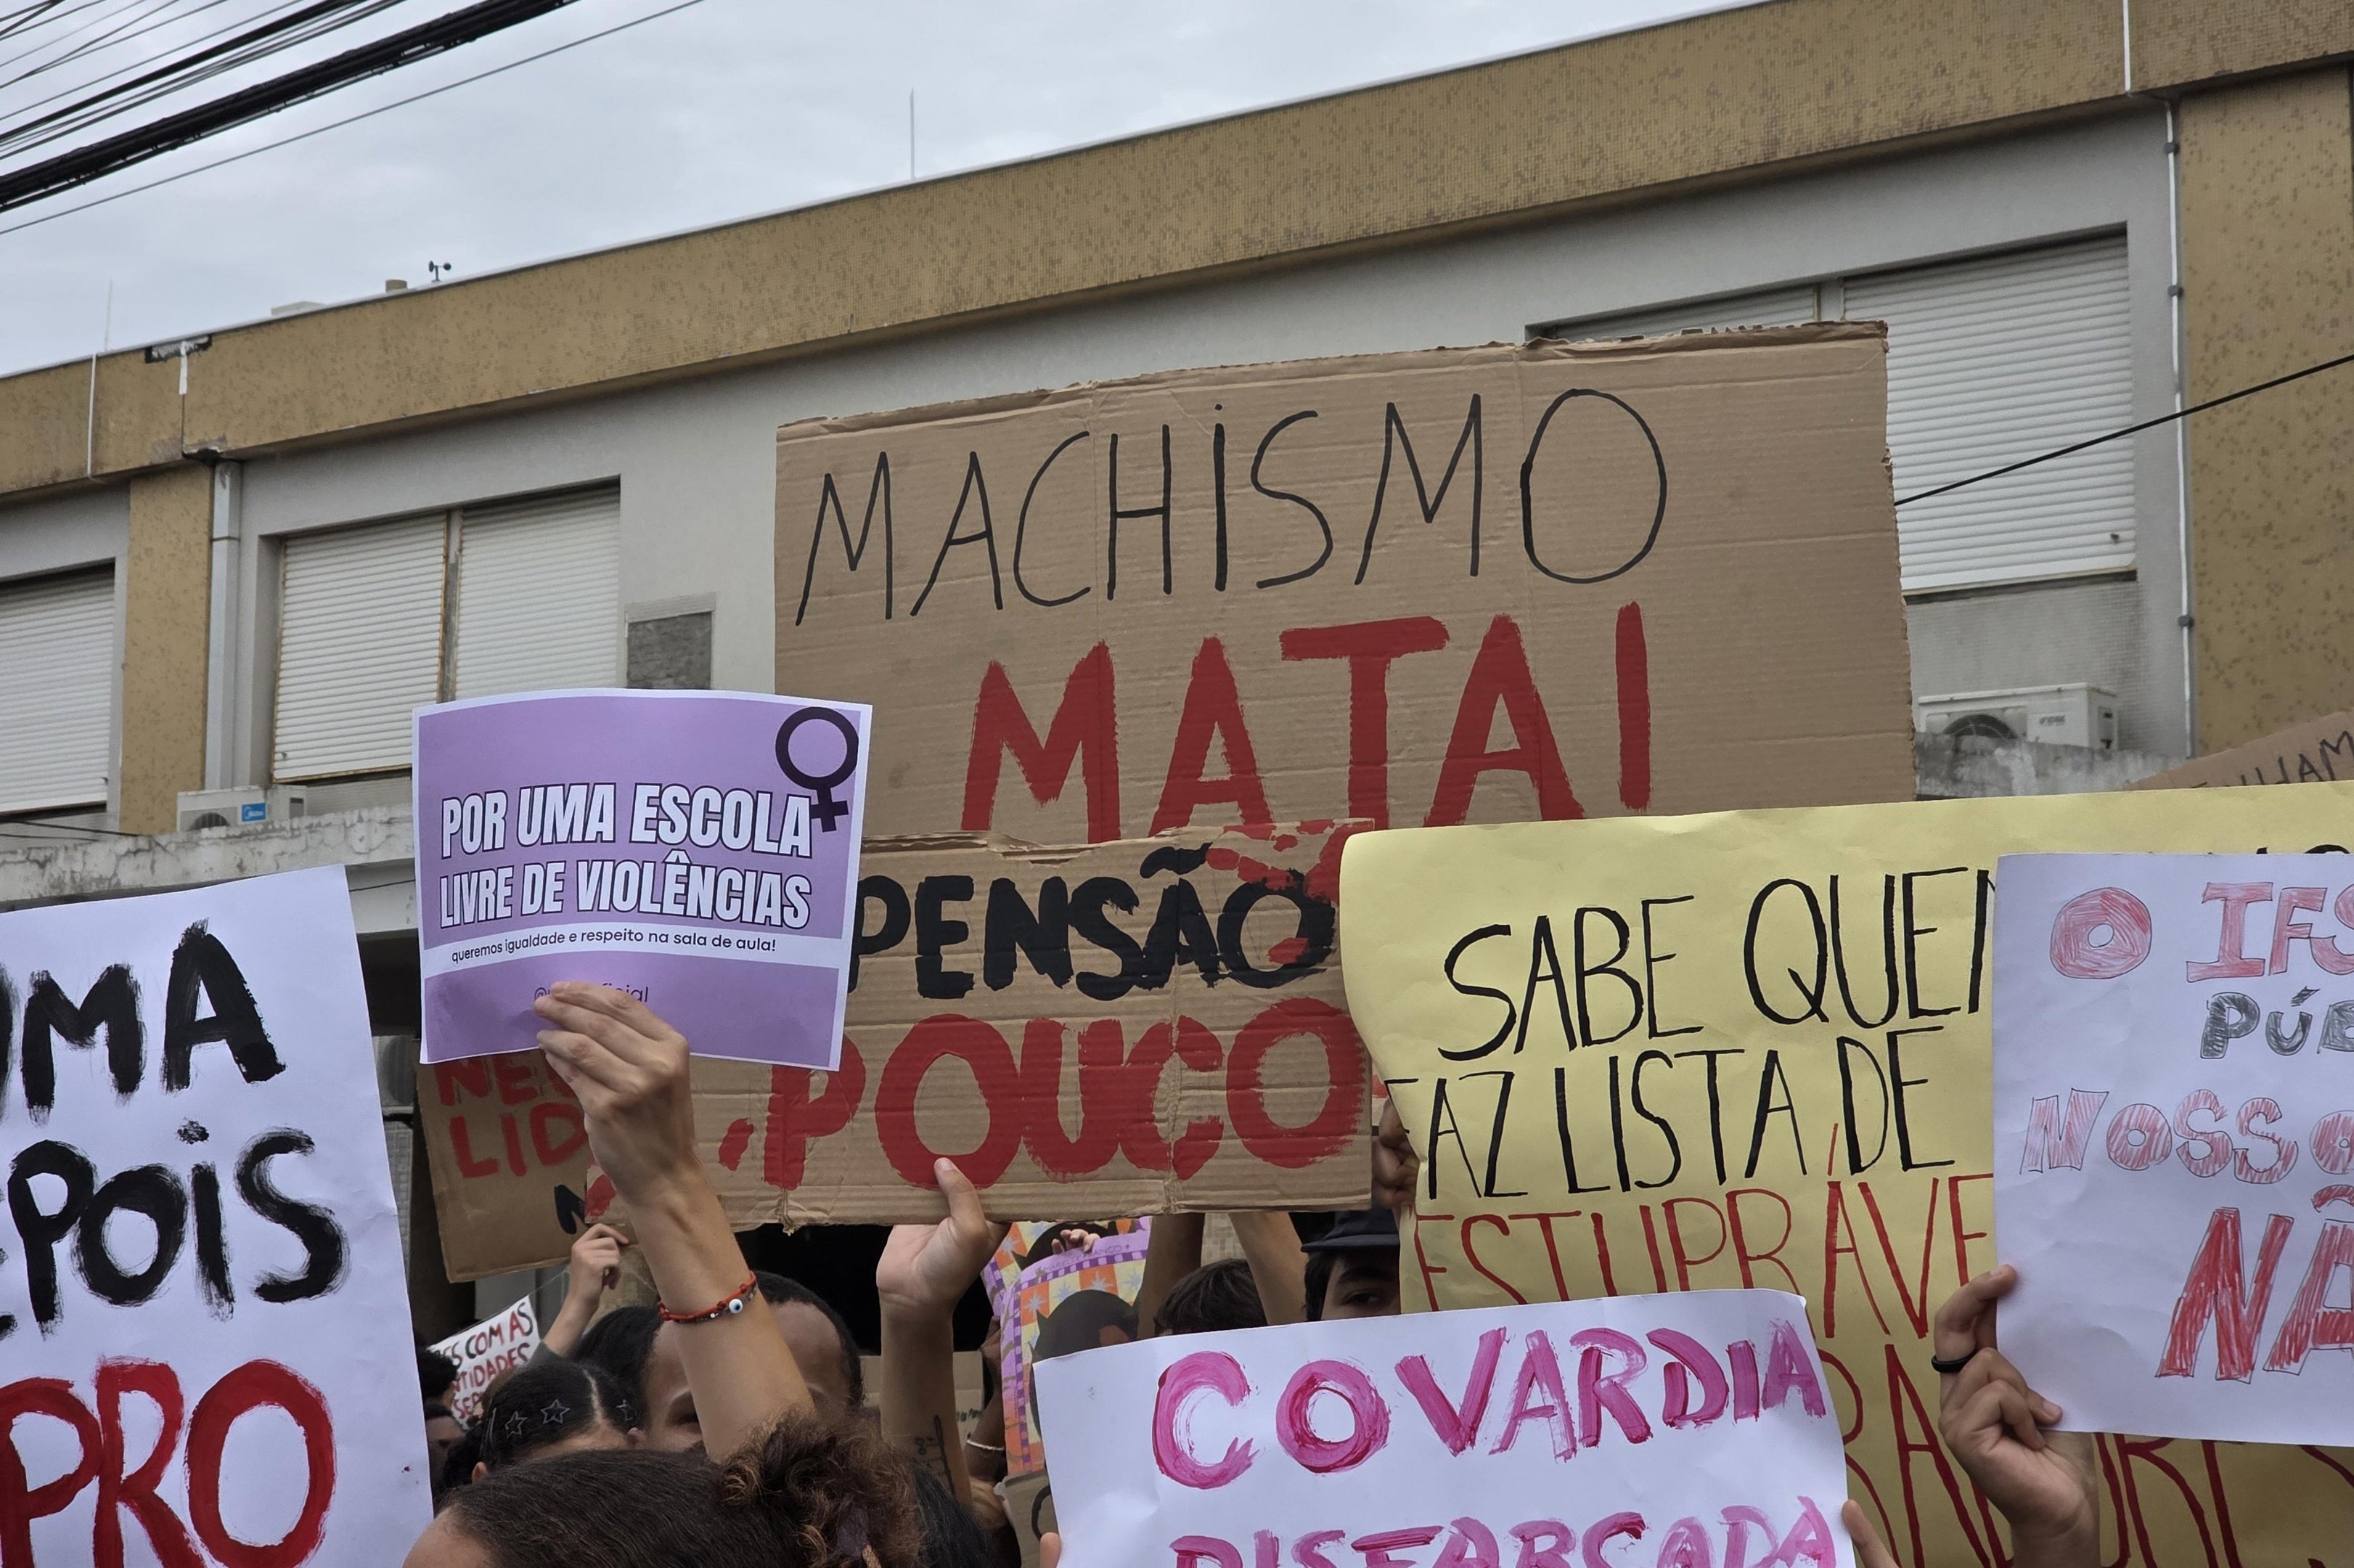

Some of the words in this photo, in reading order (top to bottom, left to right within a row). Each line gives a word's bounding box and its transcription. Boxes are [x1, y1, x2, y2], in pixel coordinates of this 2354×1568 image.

[441, 789, 507, 859] POR
[516, 782, 616, 848] UMA
[629, 782, 813, 859] ESCOLA
[439, 865, 513, 928] LIVRE
[520, 859, 566, 918] DE
[576, 849, 812, 929] VIOLÊNCIAS
[451, 942, 502, 964] queremos
[504, 931, 565, 954] igualdade
[568, 932, 577, 942] e
[581, 928, 644, 944] respeito
[648, 932, 669, 944] na
[673, 932, 707, 946] sala
[711, 934, 732, 948] de
[736, 937, 776, 952] aula!
[2050, 886, 2153, 980] O
[0, 918, 287, 1125] MA
[1438, 895, 1704, 1061] SABE
[433, 1051, 579, 1106] NE
[764, 997, 1367, 1191] POUCO
[1556, 1049, 1808, 1194] LISTA
[1836, 1026, 1957, 1175] DE
[0, 1120, 350, 1342] POIS
[465, 1323, 504, 1360] COM
[510, 1302, 534, 1343] AS
[1152, 1320, 1827, 1490] COVARDIA
